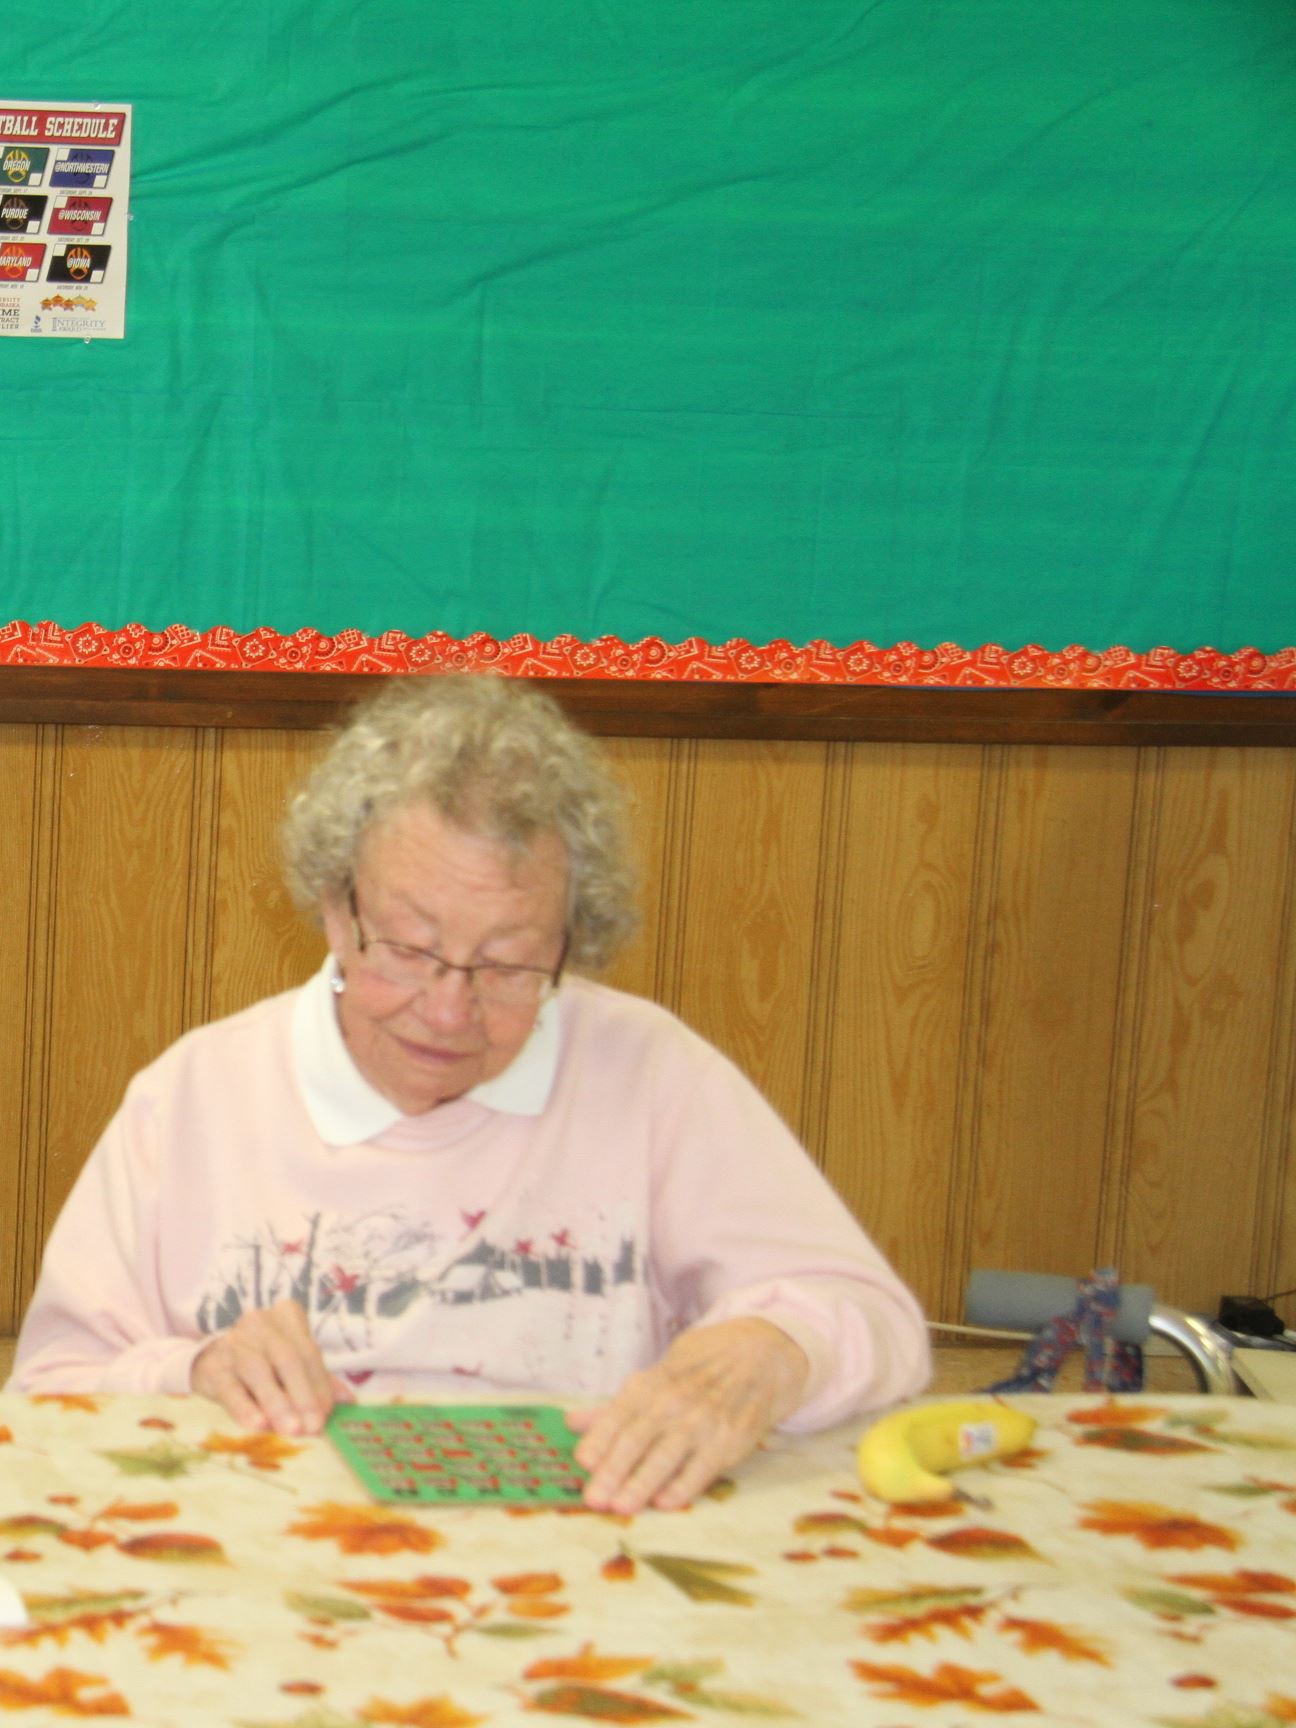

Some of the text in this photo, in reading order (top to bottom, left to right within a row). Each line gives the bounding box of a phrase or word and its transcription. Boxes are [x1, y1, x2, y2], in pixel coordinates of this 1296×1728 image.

[45, 117, 118, 138] SCHEDULE
[3, 160, 30, 171] OREGON
[55, 162, 109, 173] @NORTHWESTERN
[1, 208, 28, 219] PURDUE
[59, 209, 101, 220] @WISCONSIN
[67, 258, 91, 268] @IOWA
